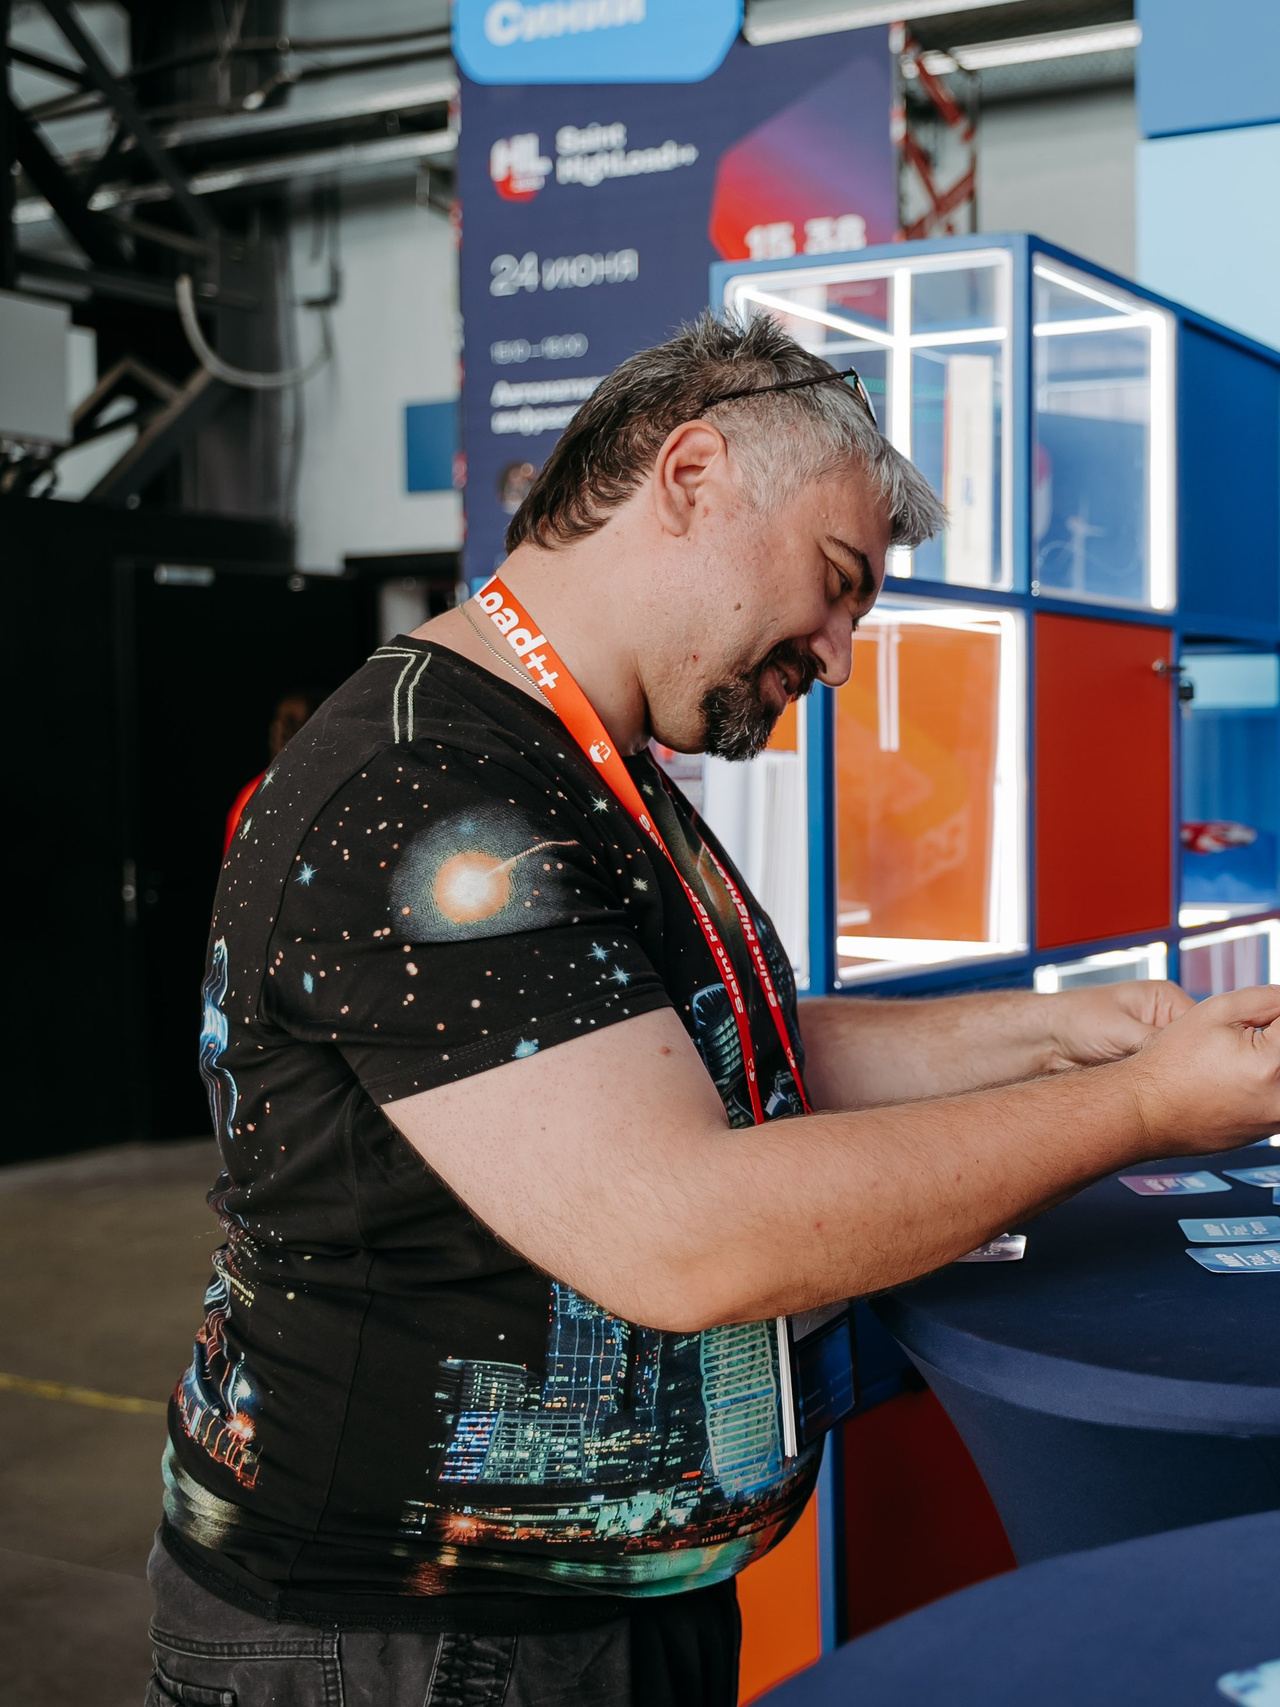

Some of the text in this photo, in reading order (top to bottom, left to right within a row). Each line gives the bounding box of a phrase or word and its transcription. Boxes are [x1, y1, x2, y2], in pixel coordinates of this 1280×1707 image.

[490, 251, 540, 296] 24
[716, 946, 745, 1014] Saint
[752, 945, 778, 1008] Saint
